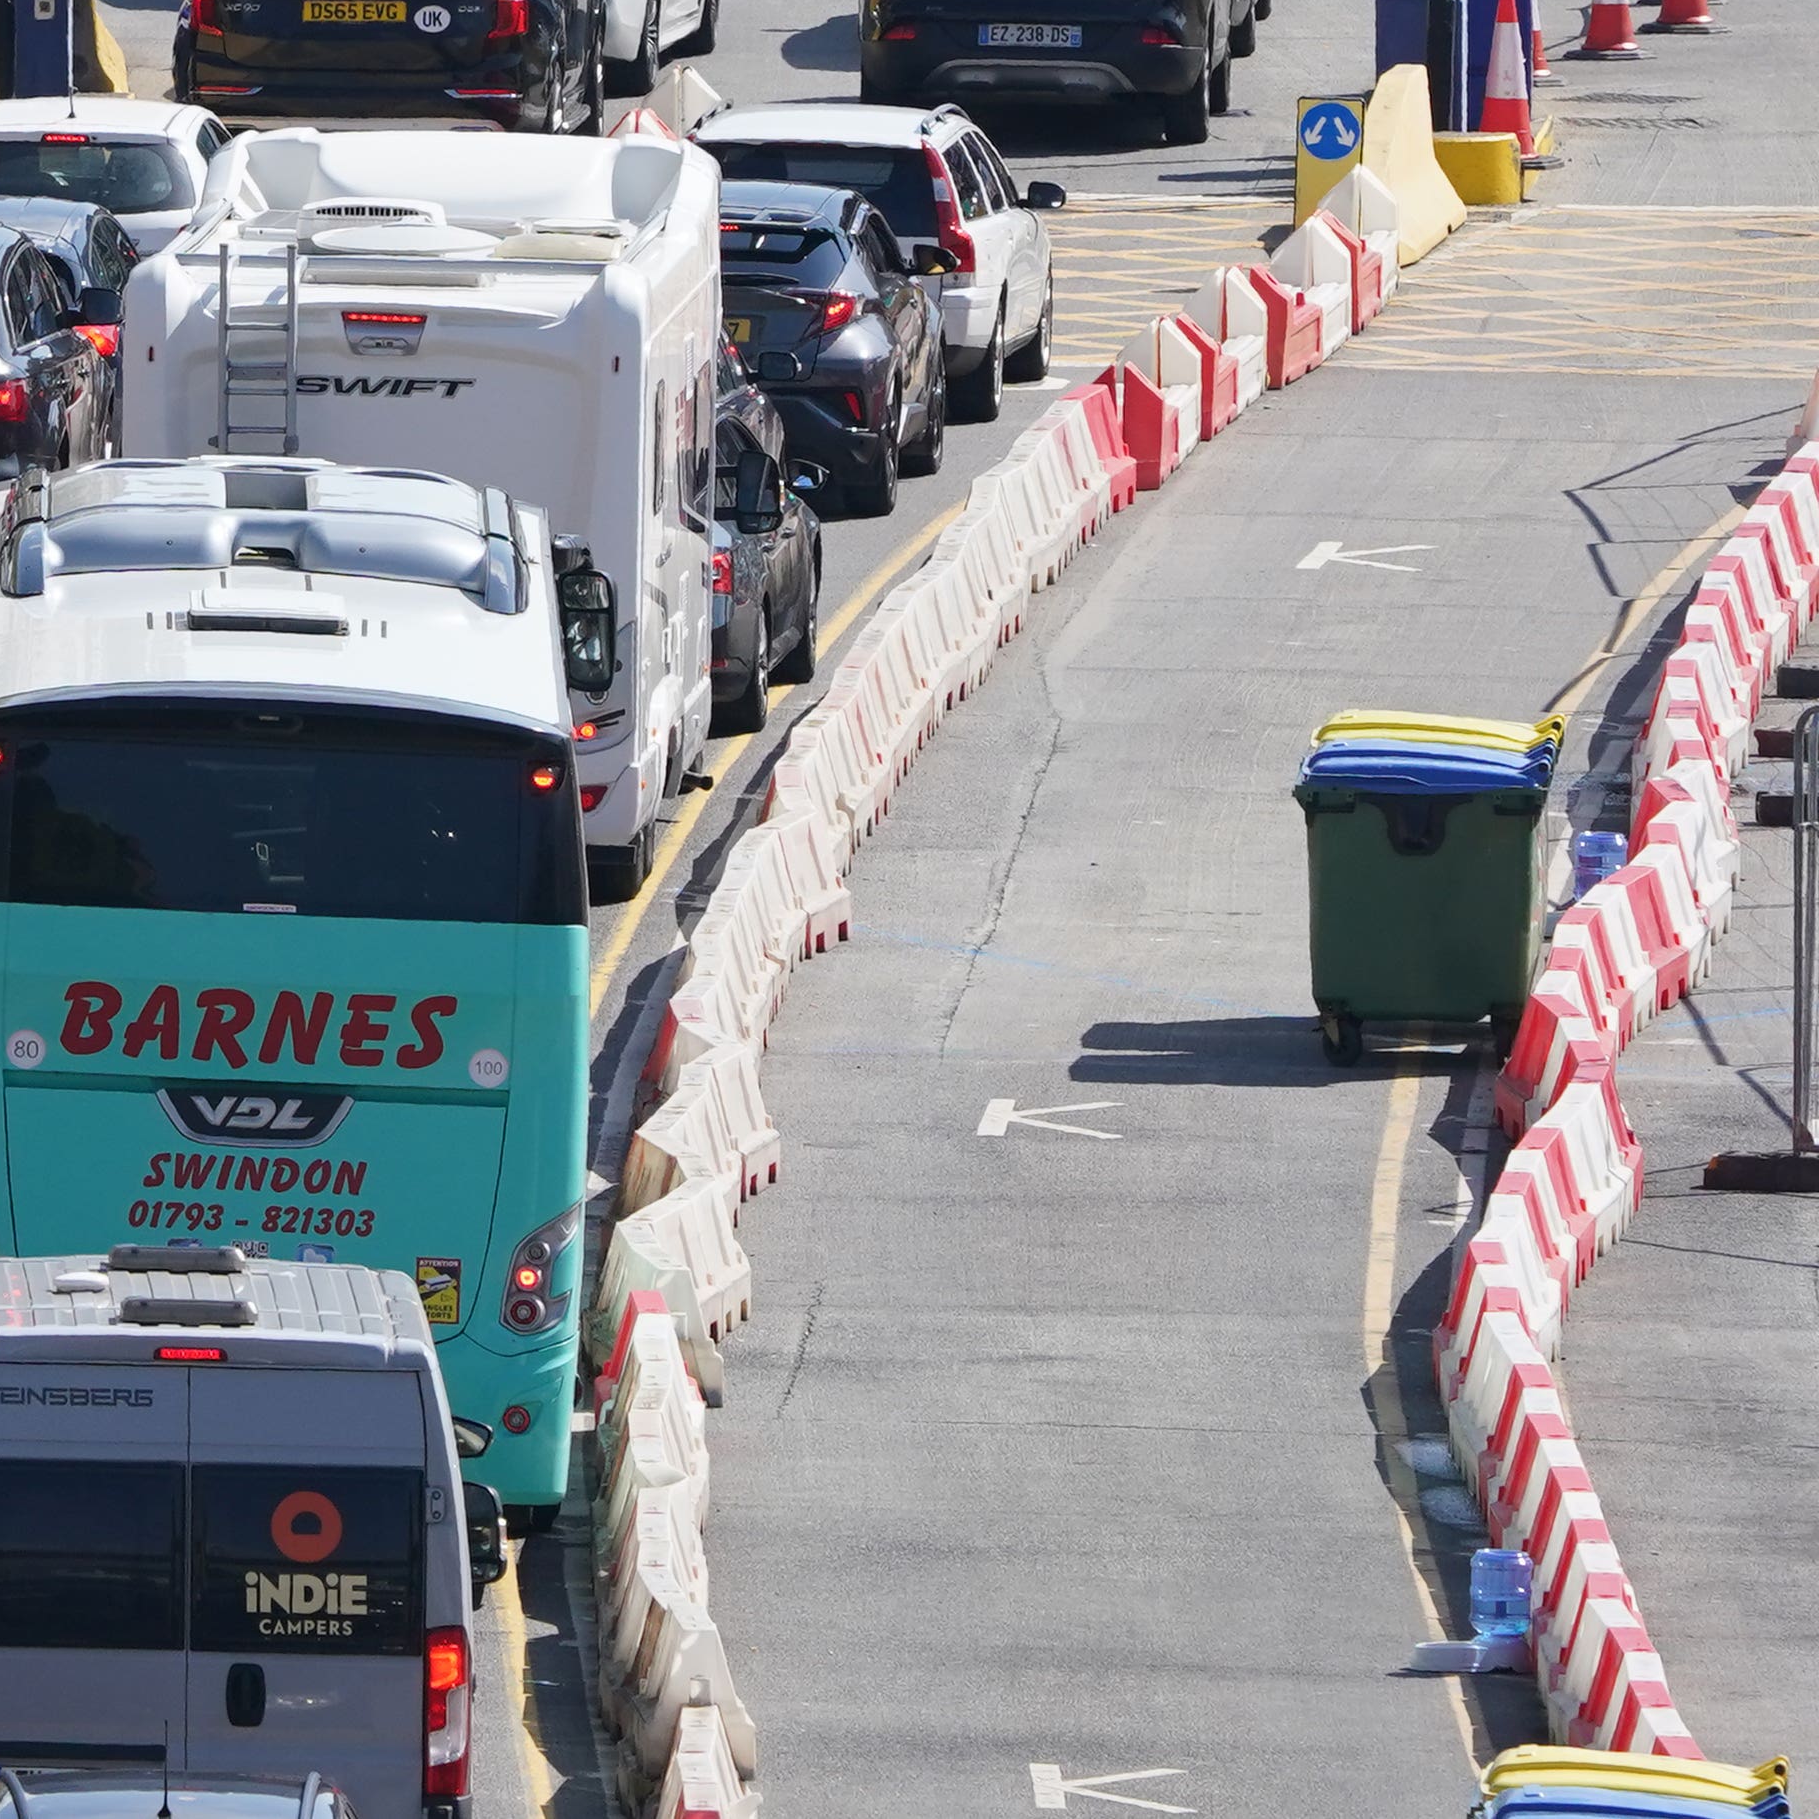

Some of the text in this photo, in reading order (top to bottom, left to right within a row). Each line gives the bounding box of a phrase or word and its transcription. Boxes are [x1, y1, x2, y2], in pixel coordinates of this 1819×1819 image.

[310, 1, 399, 22] DS65 EVG
[423, 13, 444, 29] UK
[295, 374, 477, 399] SWIFT
[59, 980, 460, 1071] BARNES
[13, 1039, 41, 1060] 80
[473, 1059, 504, 1077] 100
[189, 1094, 316, 1131] VDL
[141, 1151, 370, 1197] SWINDON
[128, 1198, 225, 1230] 01793
[261, 1203, 377, 1238] 821303
[257, 1617, 354, 1637] CAMPERS
